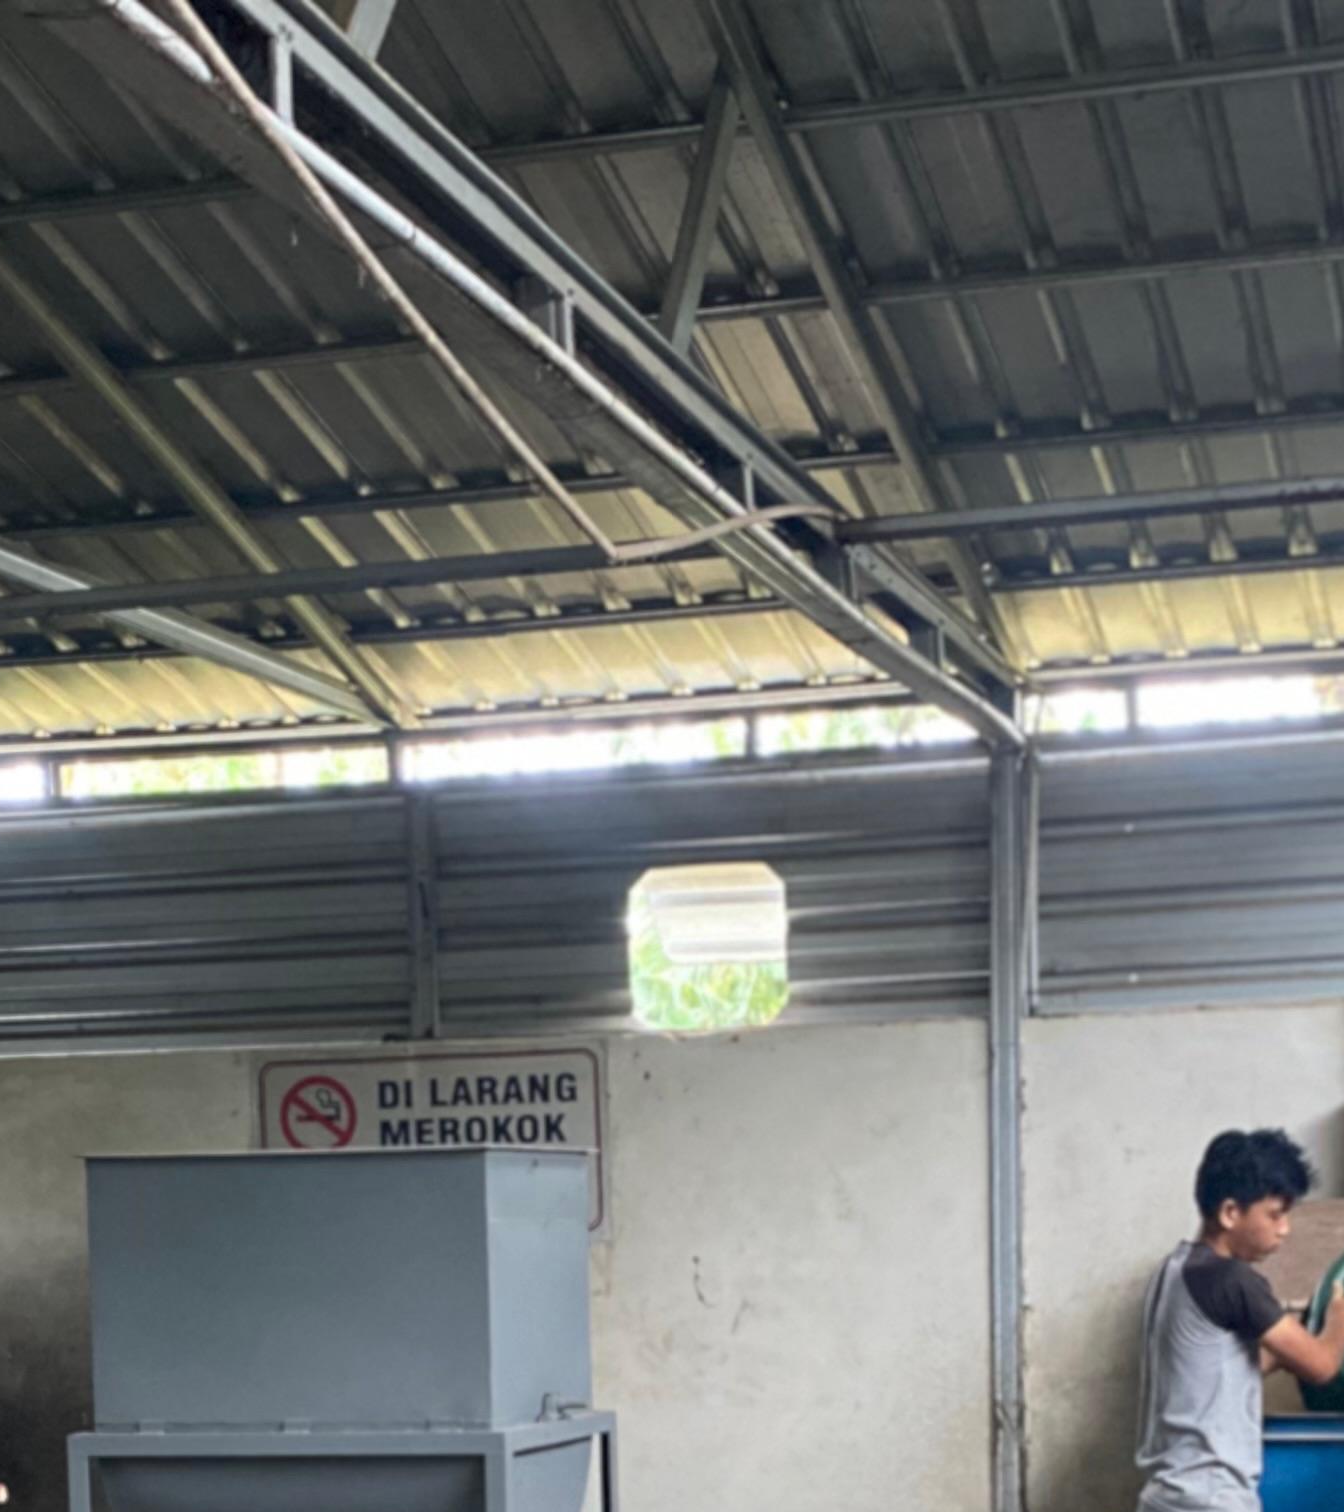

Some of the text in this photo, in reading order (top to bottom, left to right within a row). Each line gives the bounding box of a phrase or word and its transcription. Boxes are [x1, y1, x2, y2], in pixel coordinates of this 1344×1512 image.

[377, 1073, 578, 1110] DI LARANG
[379, 1113, 567, 1147] MEROKOK
